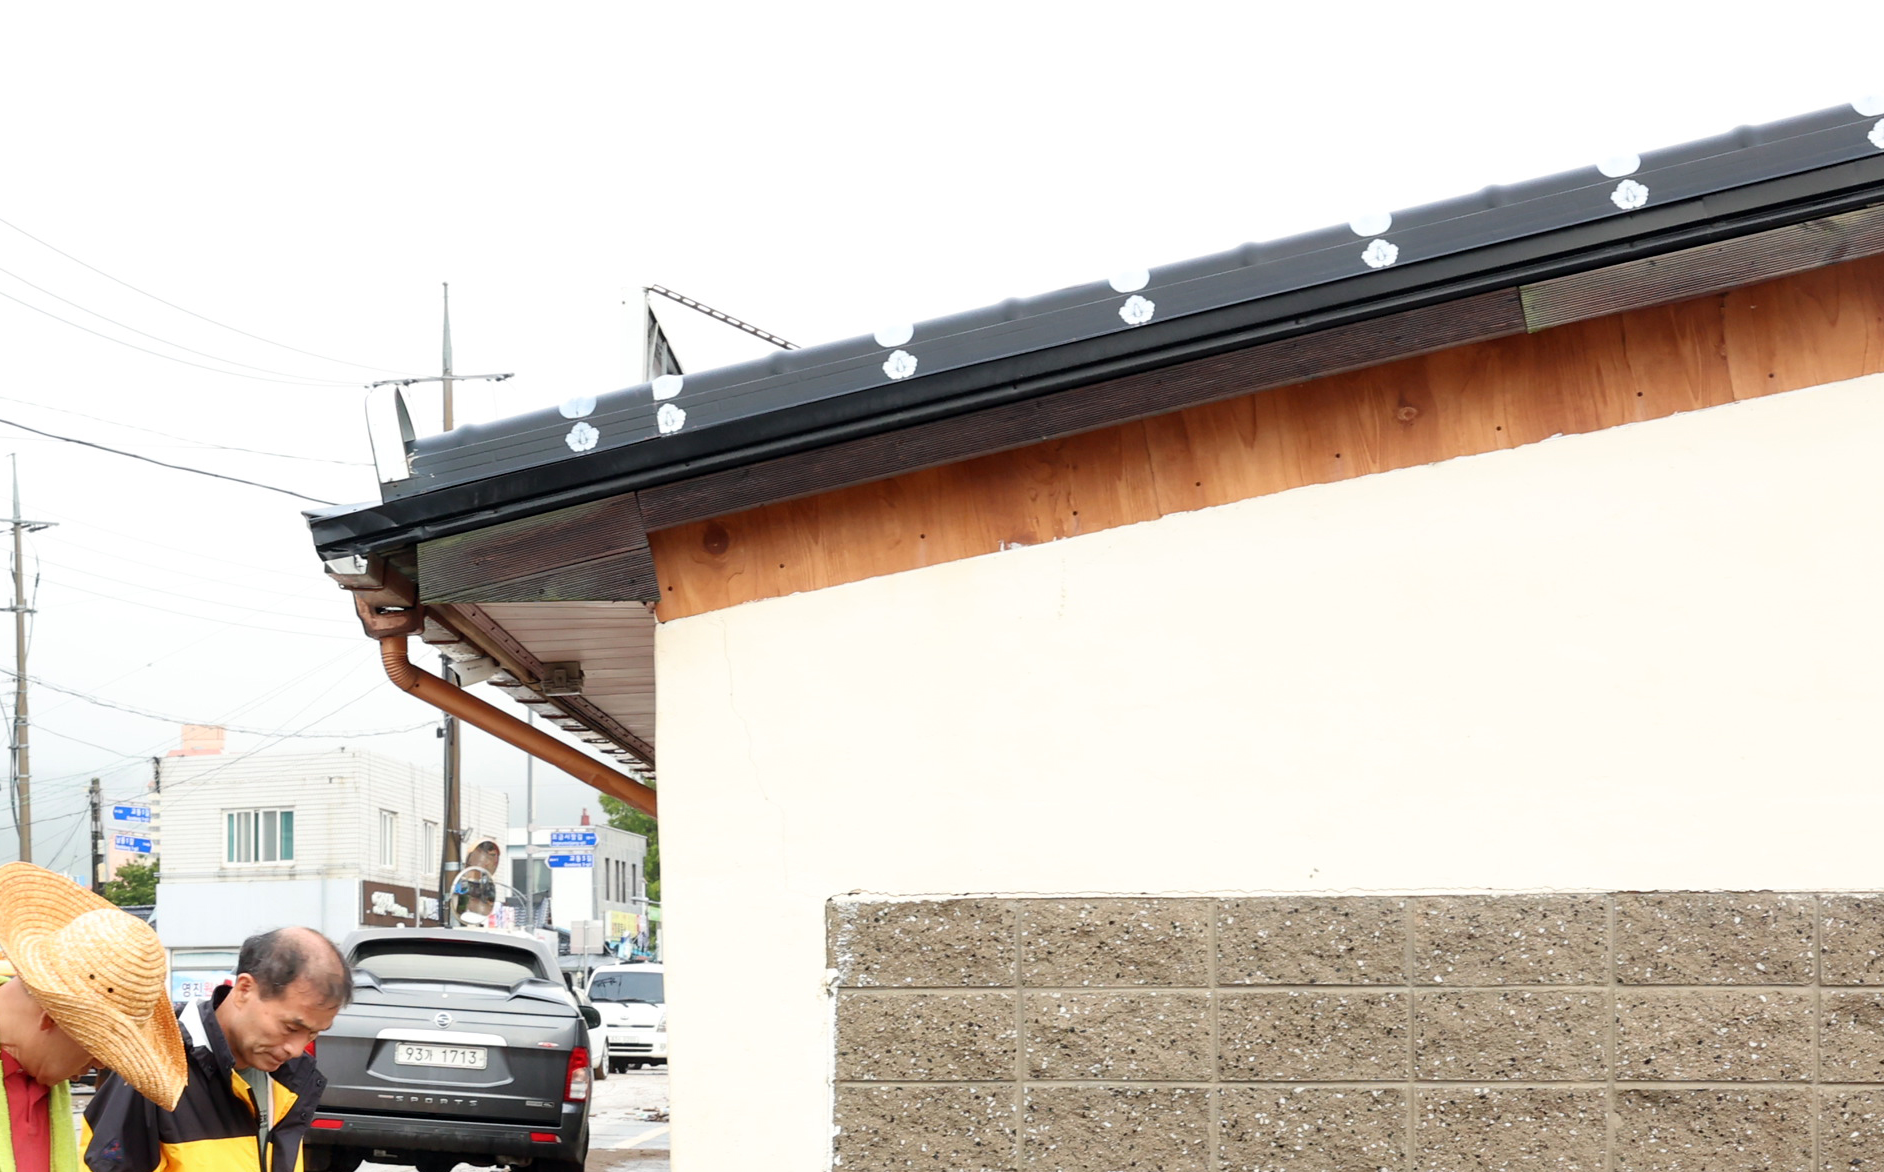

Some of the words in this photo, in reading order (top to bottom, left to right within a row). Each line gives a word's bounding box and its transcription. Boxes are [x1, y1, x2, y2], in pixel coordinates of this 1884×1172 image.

[405, 1046, 433, 1062] 93가
[441, 1049, 477, 1065] 1713
[395, 1095, 479, 1107] SPORTS
